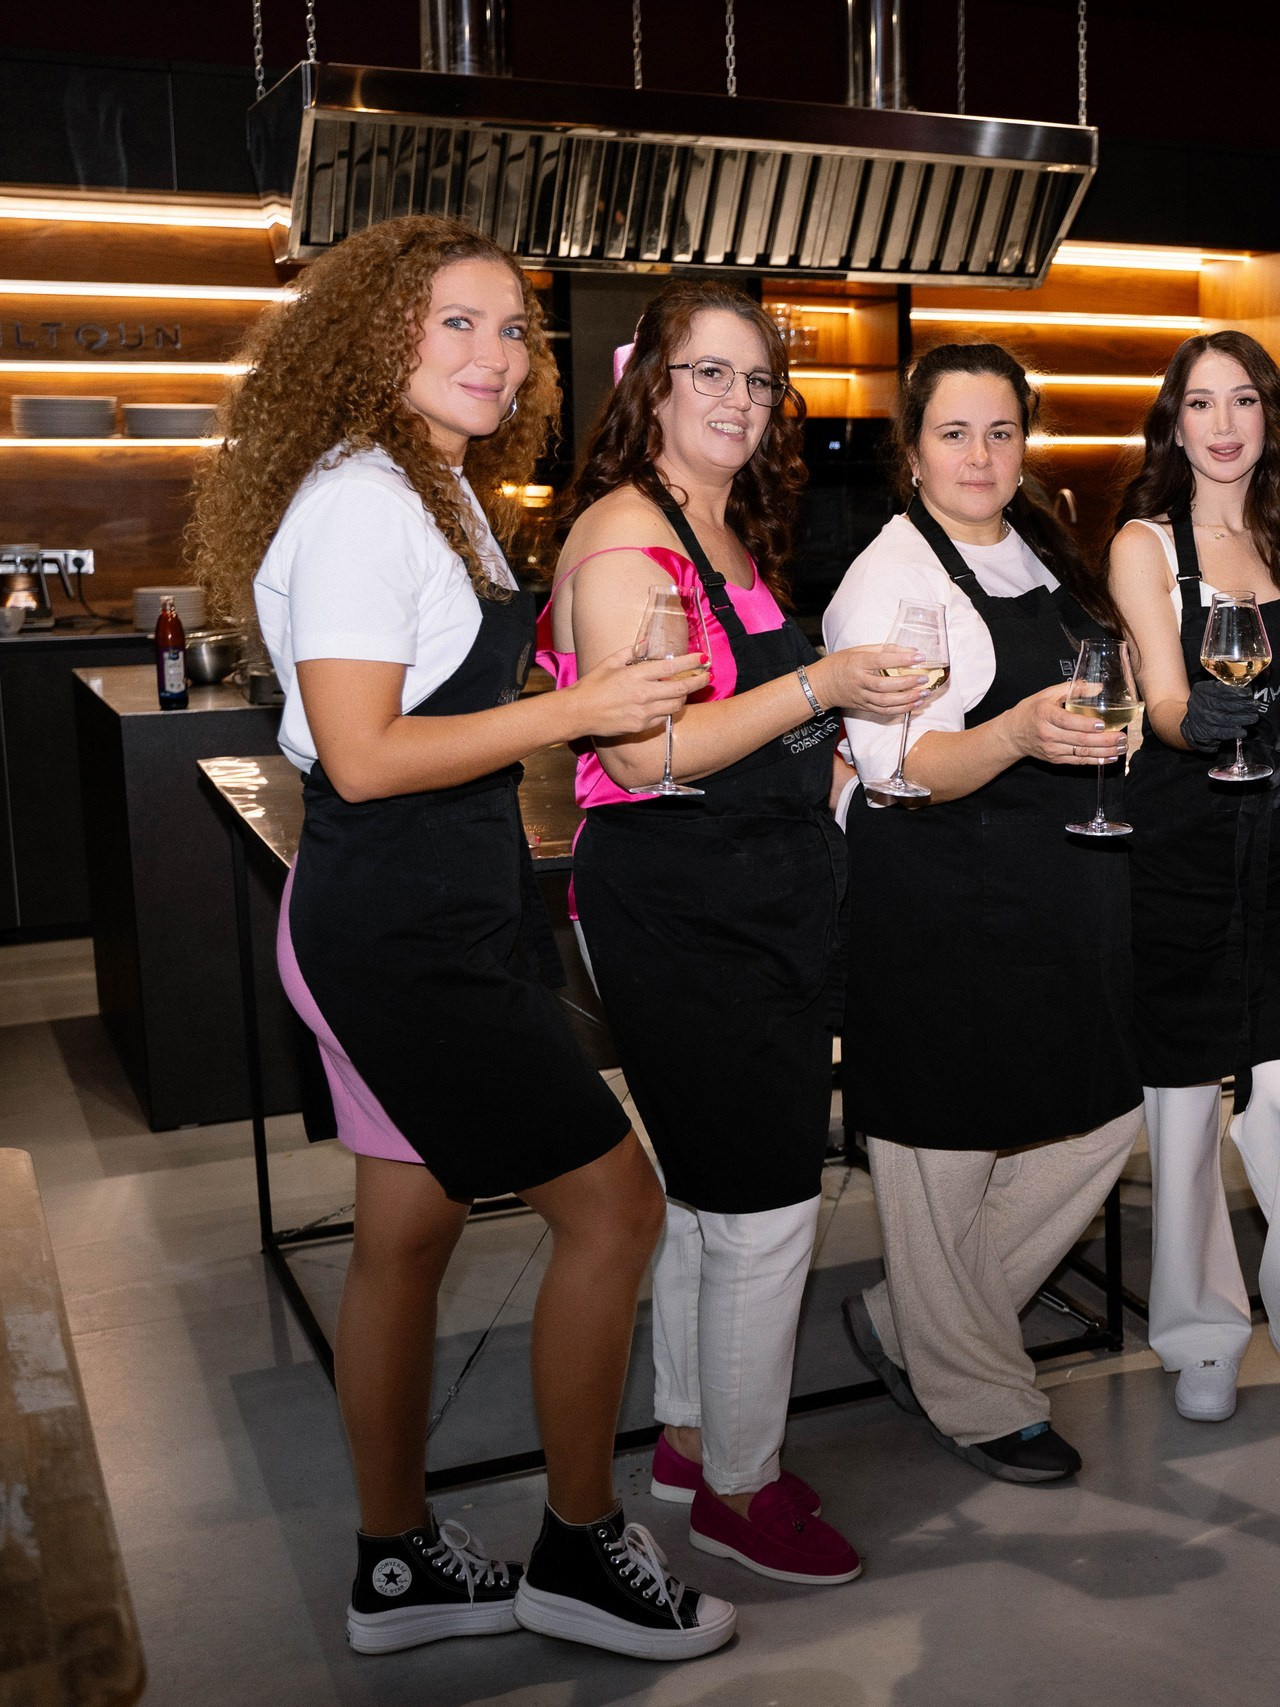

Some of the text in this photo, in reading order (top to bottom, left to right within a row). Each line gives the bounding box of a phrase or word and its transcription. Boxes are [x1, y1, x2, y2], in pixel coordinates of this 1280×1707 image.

[378, 1561, 407, 1573] CONVERSE
[378, 1585, 405, 1593] ALL STAR
